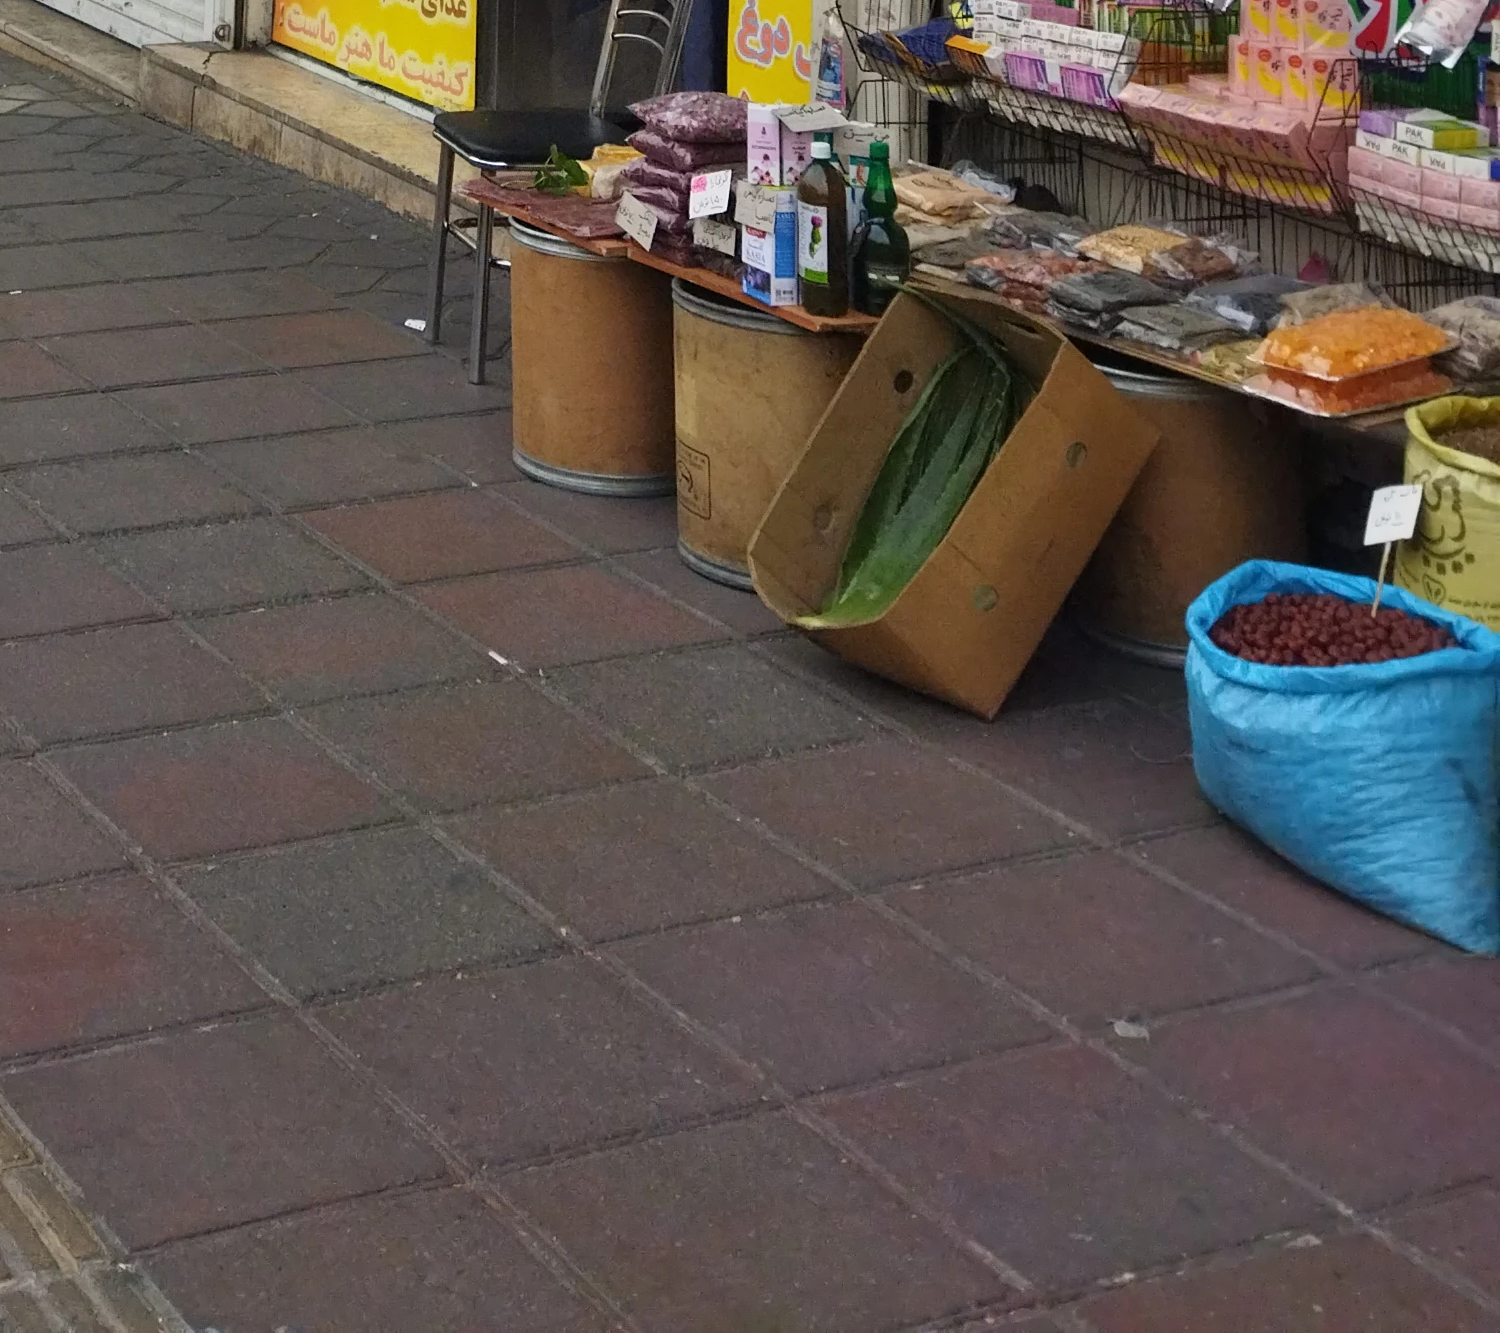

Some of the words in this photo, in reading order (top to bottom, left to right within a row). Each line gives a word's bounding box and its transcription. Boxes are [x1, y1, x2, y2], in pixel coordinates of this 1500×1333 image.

[340, 33, 373, 65] هنر
[378, 36, 396, 72] ما
[401, 54, 469, 98] کیفیت
[1392, 144, 1409, 157] PAK
[1405, 127, 1424, 142] PAK
